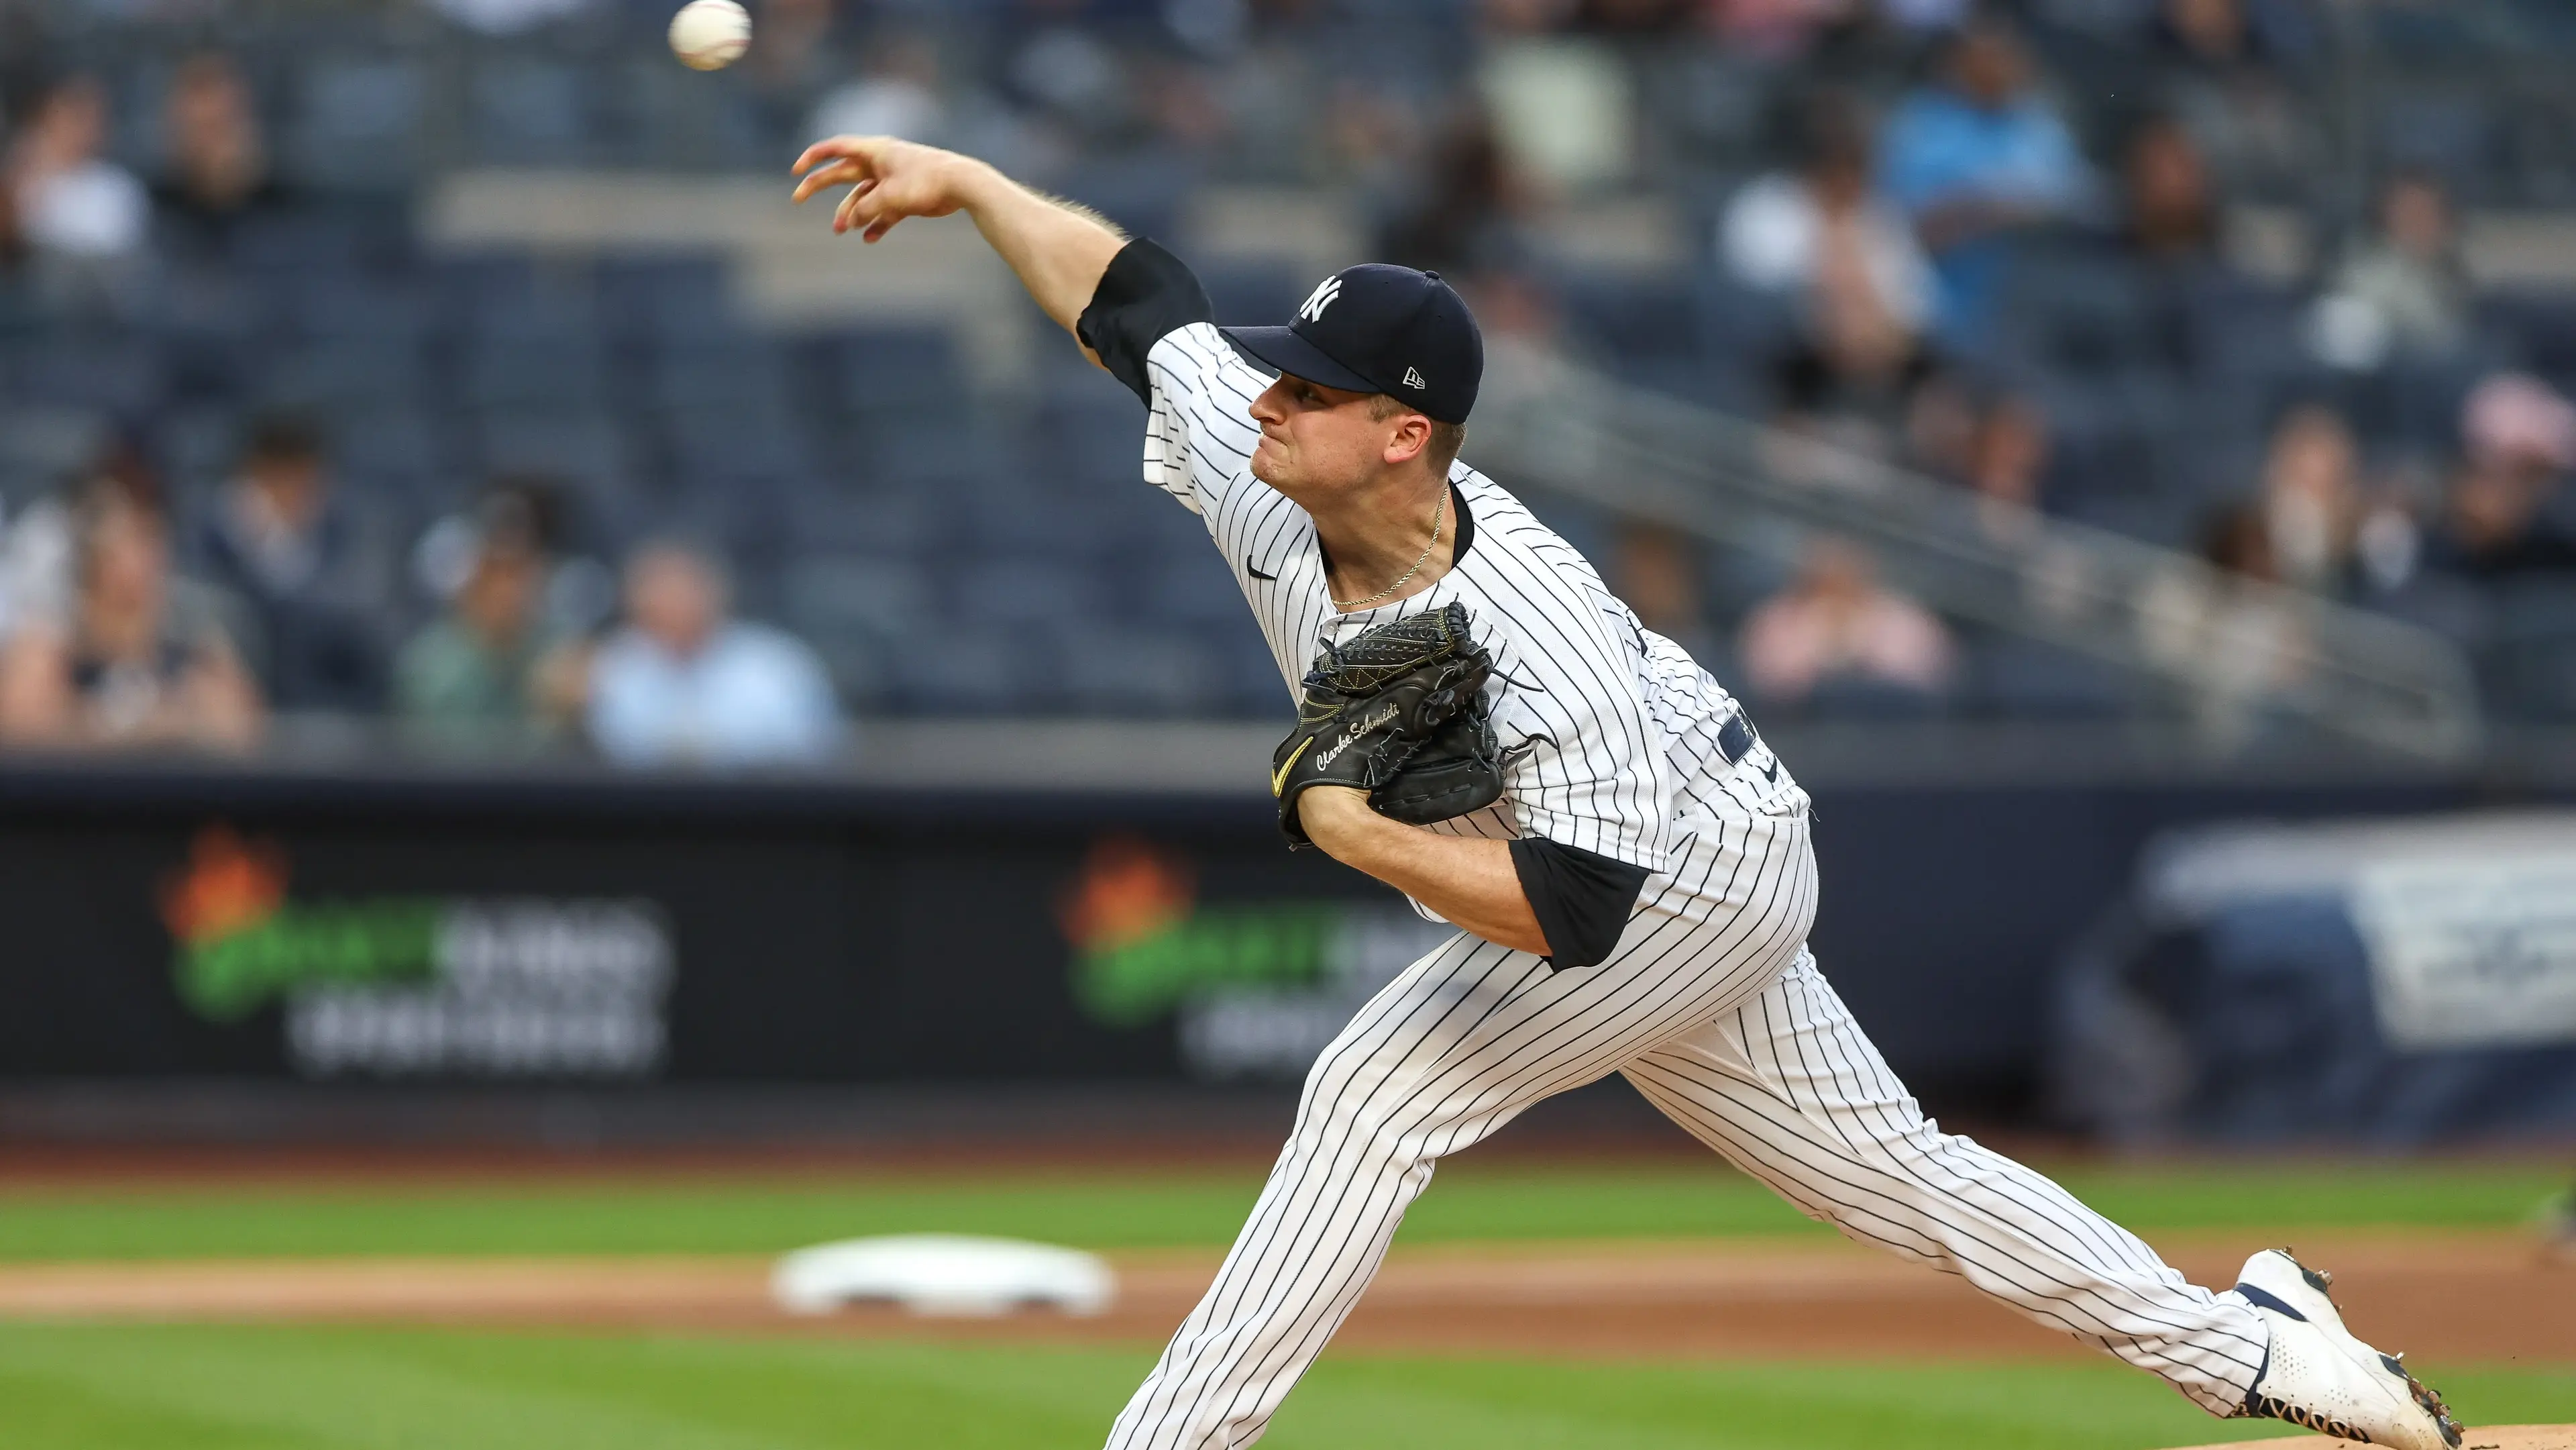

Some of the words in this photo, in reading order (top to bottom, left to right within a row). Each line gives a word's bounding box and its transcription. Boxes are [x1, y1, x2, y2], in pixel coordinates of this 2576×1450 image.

[1299, 274, 1342, 323] NY
[1316, 734, 1353, 772] Clarke
[1350, 703, 1400, 739] Schmidt
